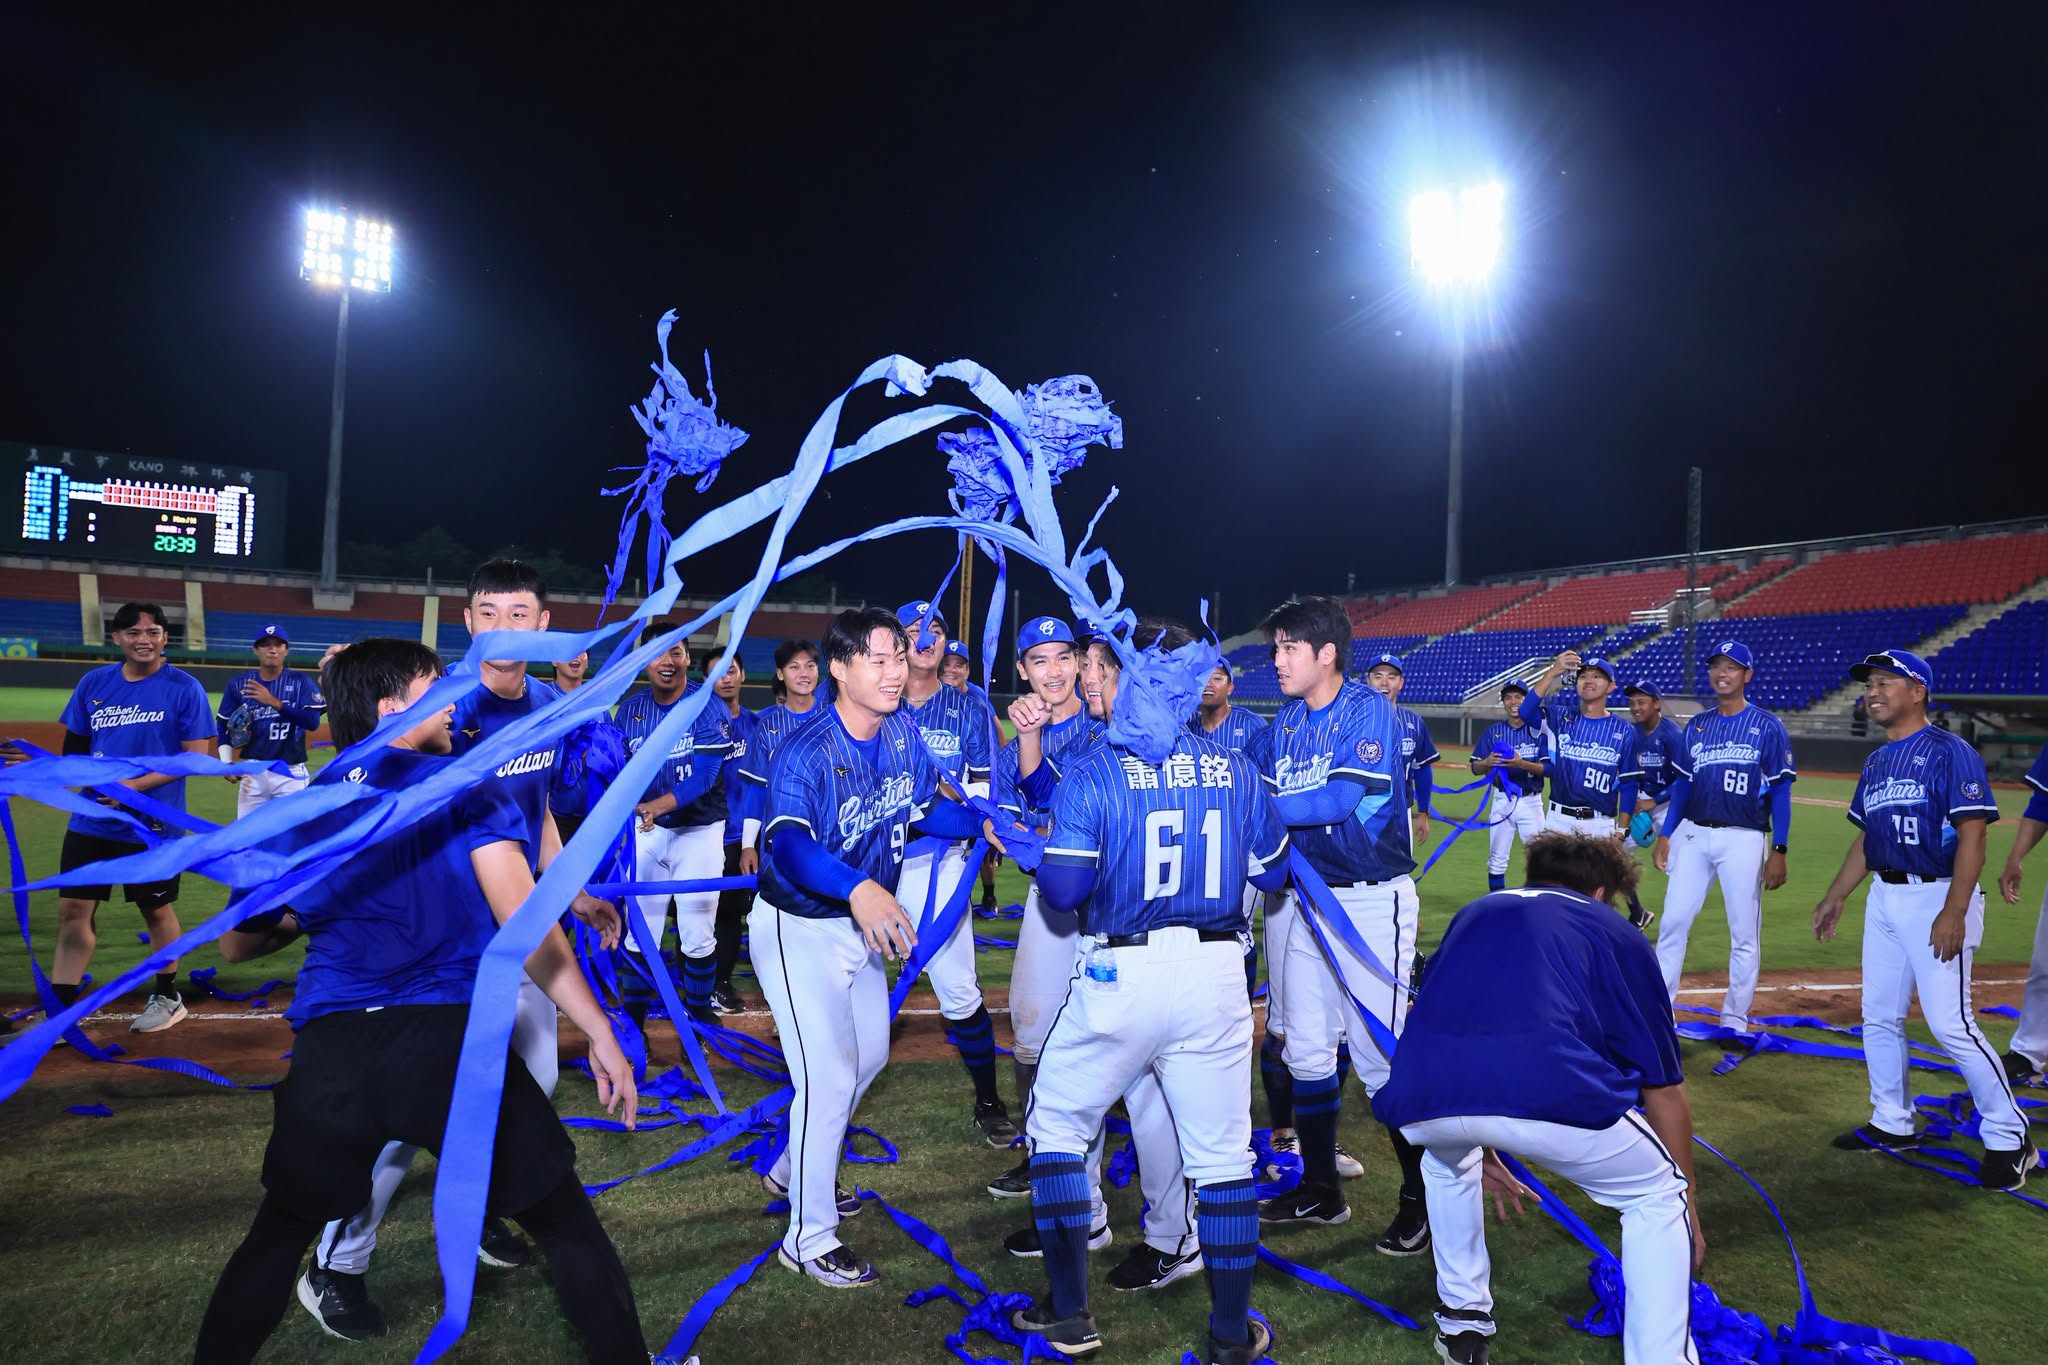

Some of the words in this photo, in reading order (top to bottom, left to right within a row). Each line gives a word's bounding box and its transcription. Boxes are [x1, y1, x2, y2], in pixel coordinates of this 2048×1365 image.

[128, 460, 164, 473] KANO
[154, 535, 196, 553] 20:39
[91, 705, 164, 731] Guardians
[103, 705, 133, 717] Fubon
[269, 722, 290, 740] 62
[1558, 734, 1621, 764] Guardians
[1691, 741, 1760, 773] Guardians
[1120, 753, 1233, 789] 蕭億銘
[1584, 767, 1610, 794] 910
[1724, 770, 1748, 795] 68
[1891, 815, 1920, 845] 79
[1144, 809, 1222, 901] 61
